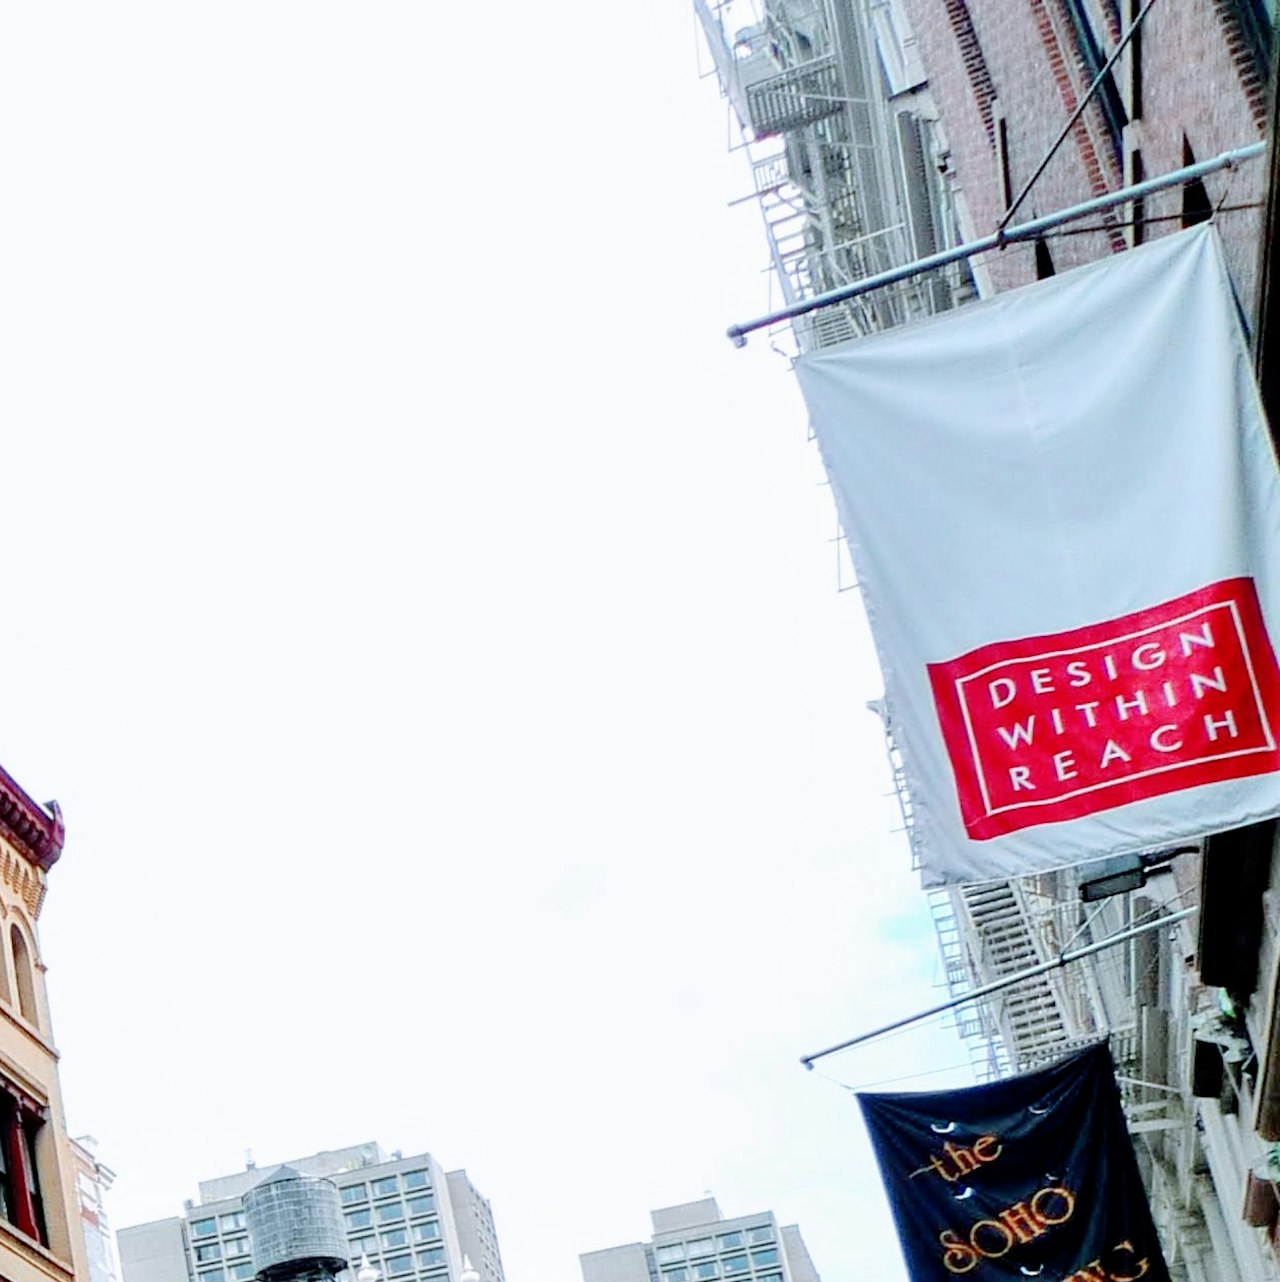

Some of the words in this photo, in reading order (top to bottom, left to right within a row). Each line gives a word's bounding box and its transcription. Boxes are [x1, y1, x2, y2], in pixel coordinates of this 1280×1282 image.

[989, 622, 1217, 711] DESIGN
[996, 666, 1228, 753] WITHIN
[1009, 708, 1240, 792] REACH
[909, 1132, 1004, 1184] the
[938, 1185, 1078, 1275] SOHO
